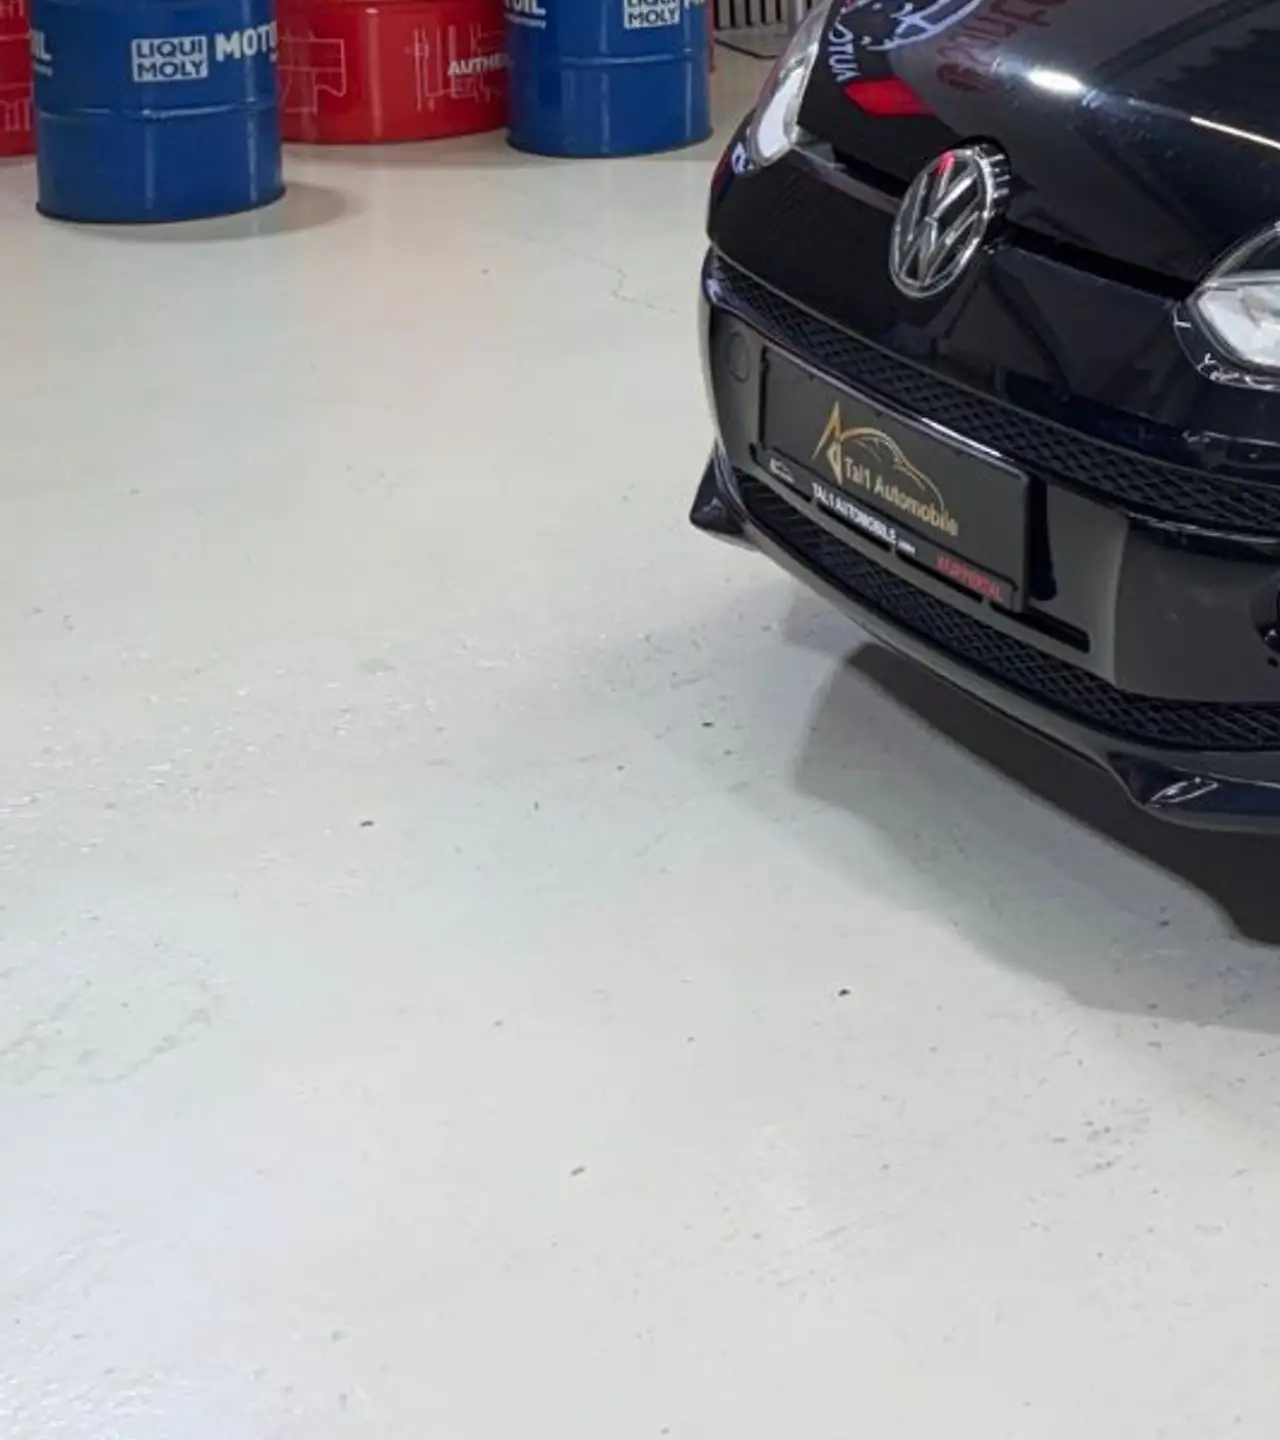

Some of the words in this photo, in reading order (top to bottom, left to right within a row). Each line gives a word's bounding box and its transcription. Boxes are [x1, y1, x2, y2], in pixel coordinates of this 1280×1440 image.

[627, 8, 677, 26] MOLY
[134, 38, 204, 60] LIQUI
[136, 60, 205, 80] MOLY
